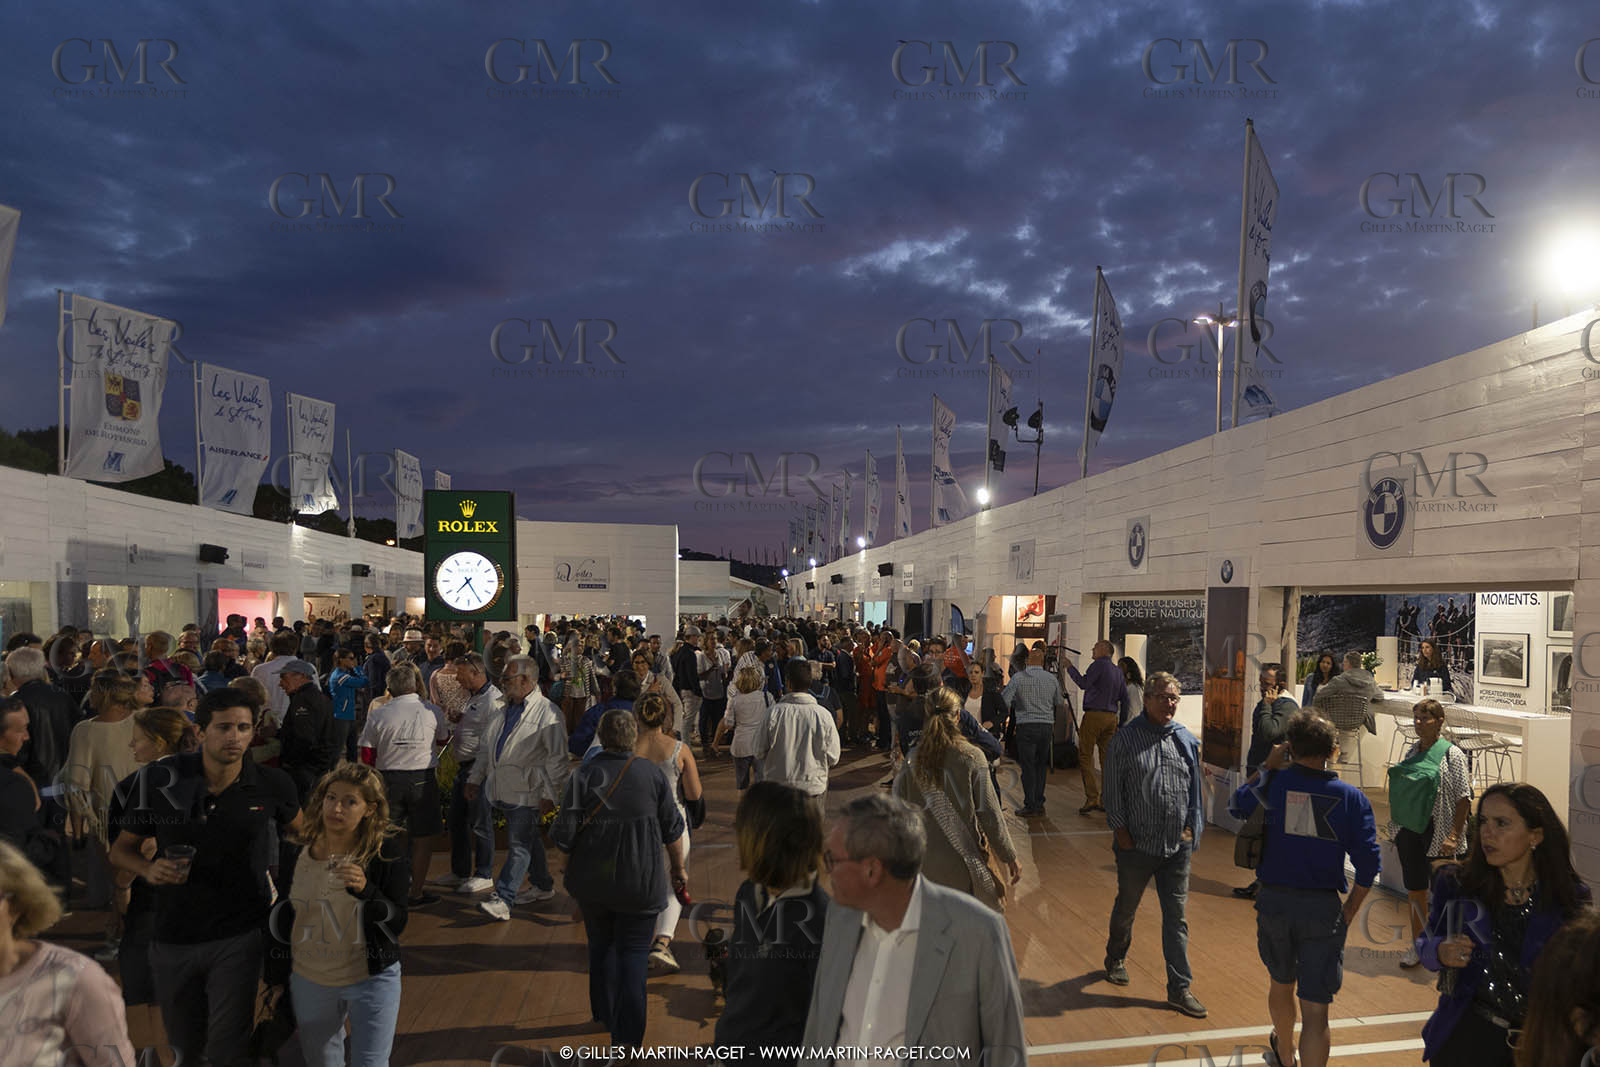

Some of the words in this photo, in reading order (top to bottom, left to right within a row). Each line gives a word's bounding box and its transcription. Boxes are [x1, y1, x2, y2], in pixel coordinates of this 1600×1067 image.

[438, 520, 498, 533] ROLEX
[1133, 599, 1155, 608] OUR
[1158, 600, 1197, 609] CLOSED
[1481, 593, 1541, 606] MOMENTS.
